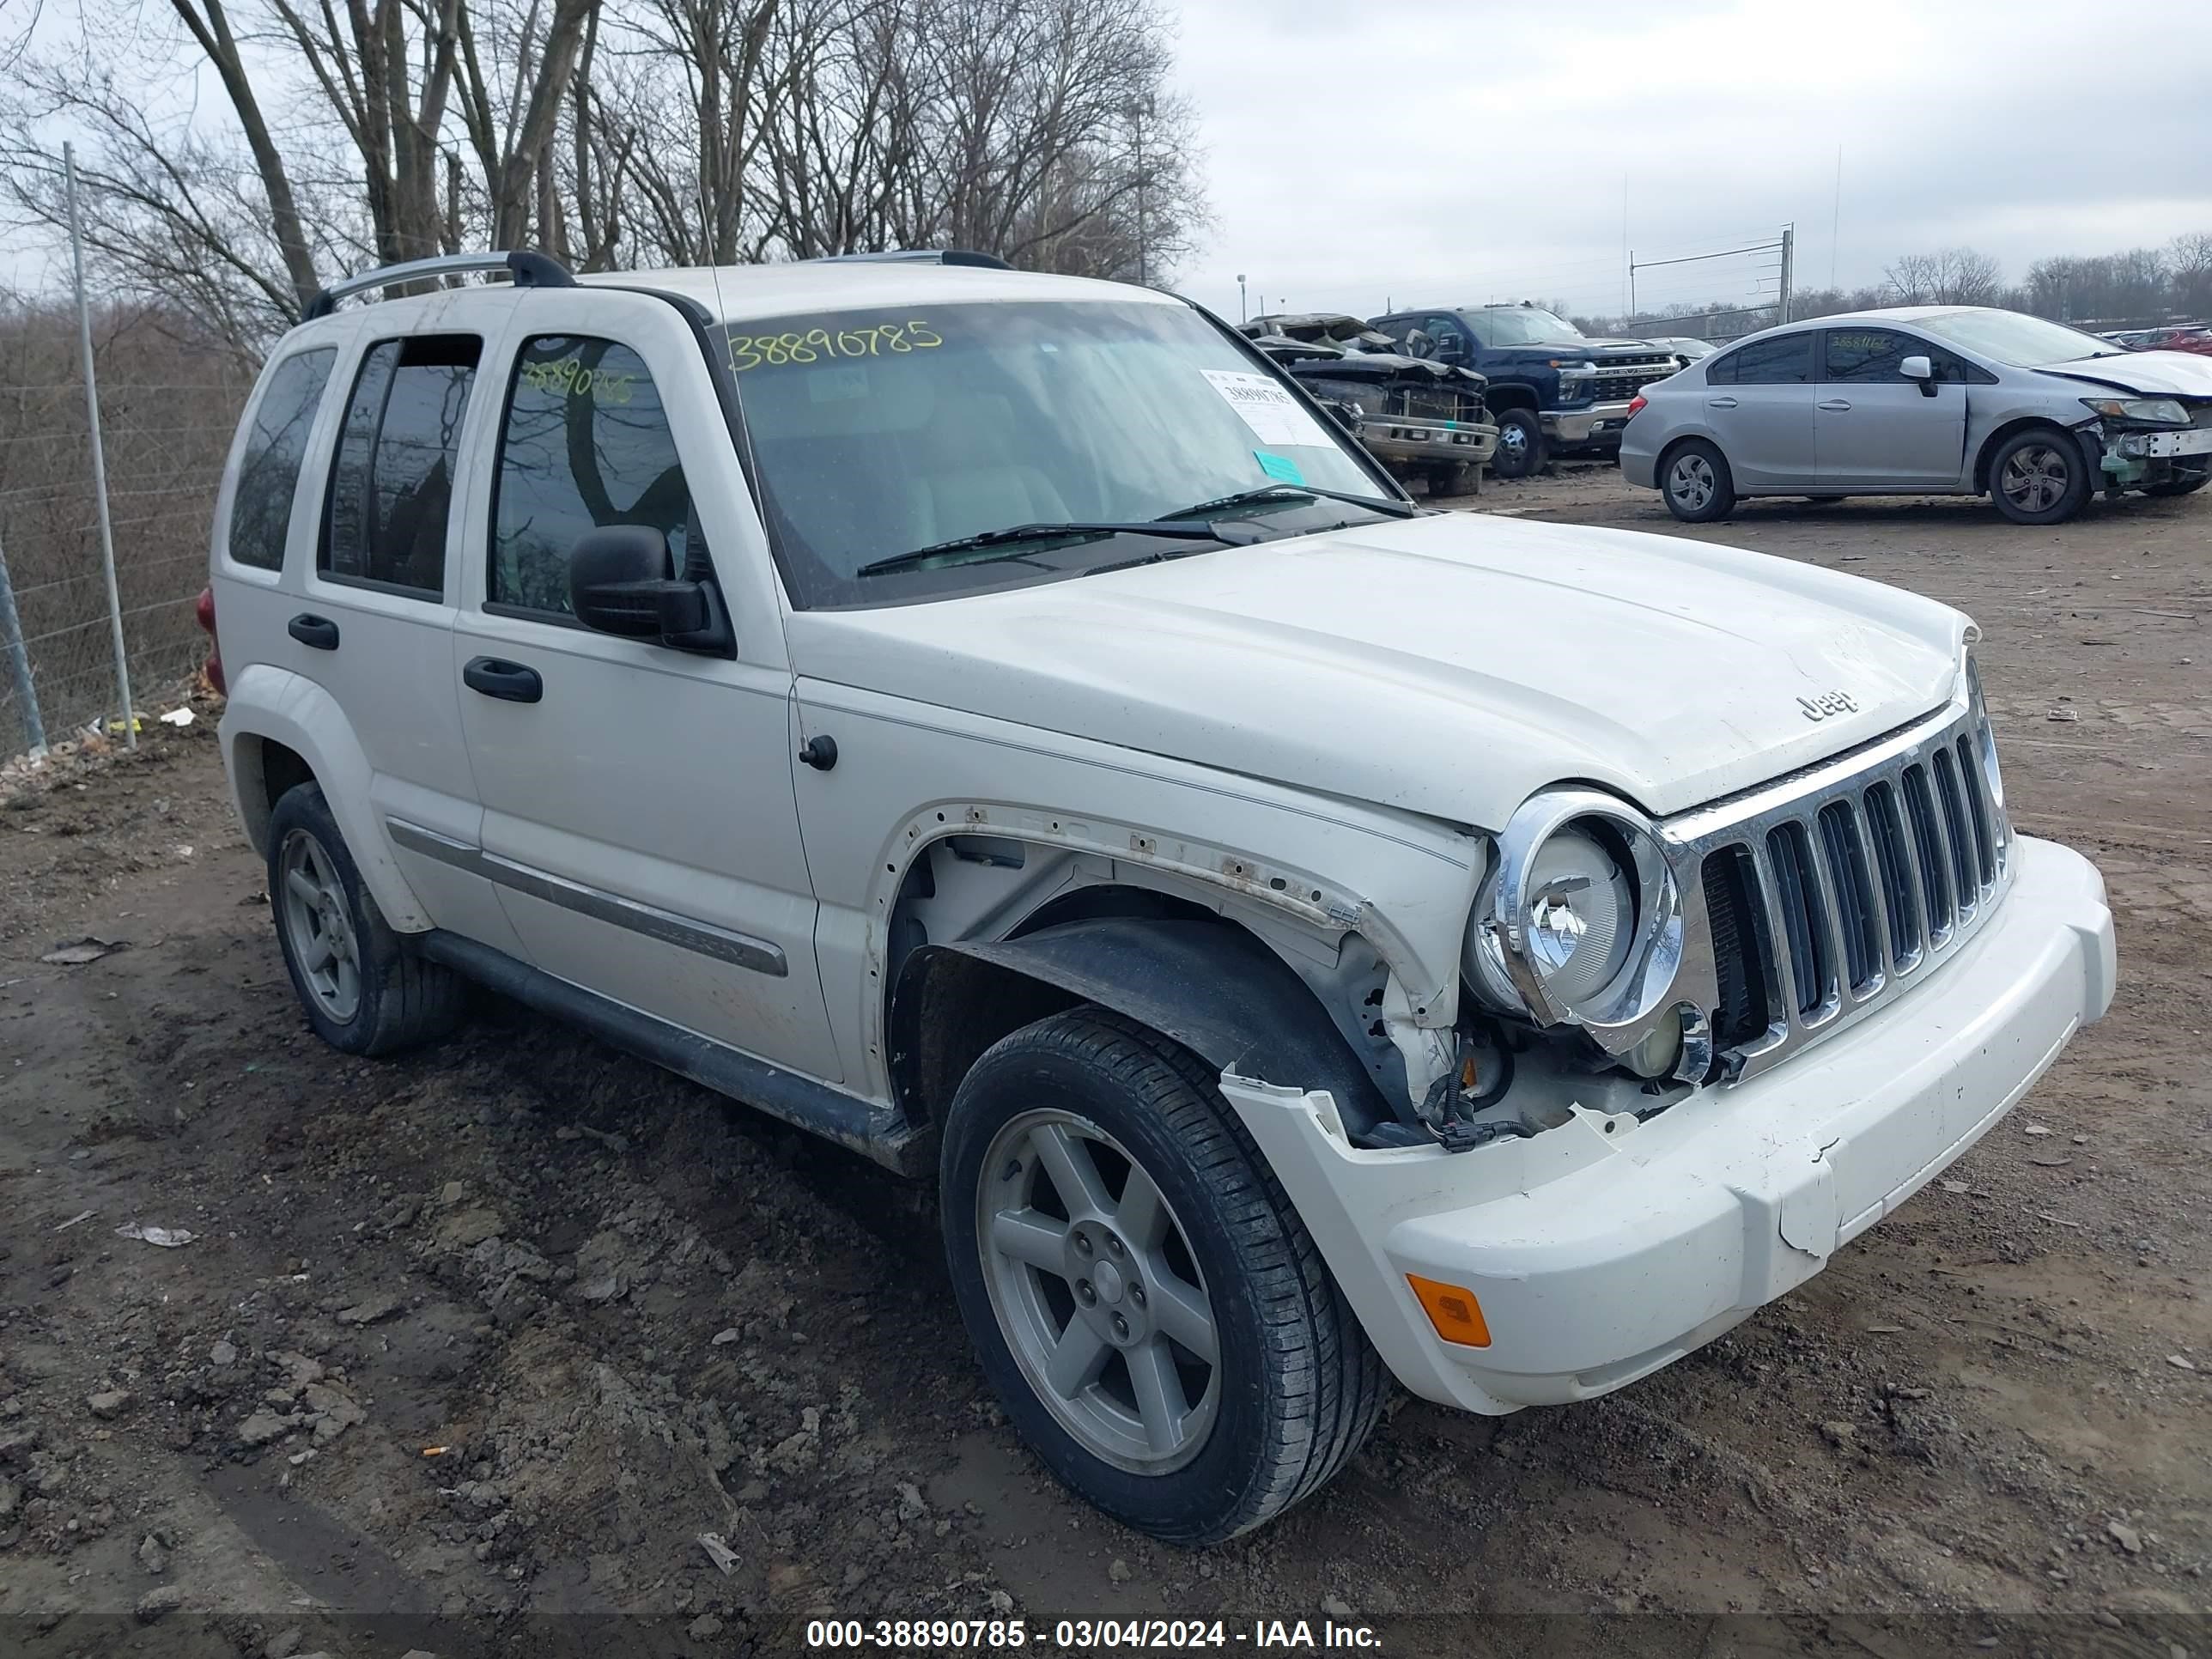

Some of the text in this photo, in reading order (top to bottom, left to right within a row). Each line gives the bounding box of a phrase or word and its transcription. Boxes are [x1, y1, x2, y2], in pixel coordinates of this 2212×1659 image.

[728, 320, 943, 371] 38890785
[1224, 386, 1291, 404] 38890785
[1796, 689, 1859, 722] Jeep
